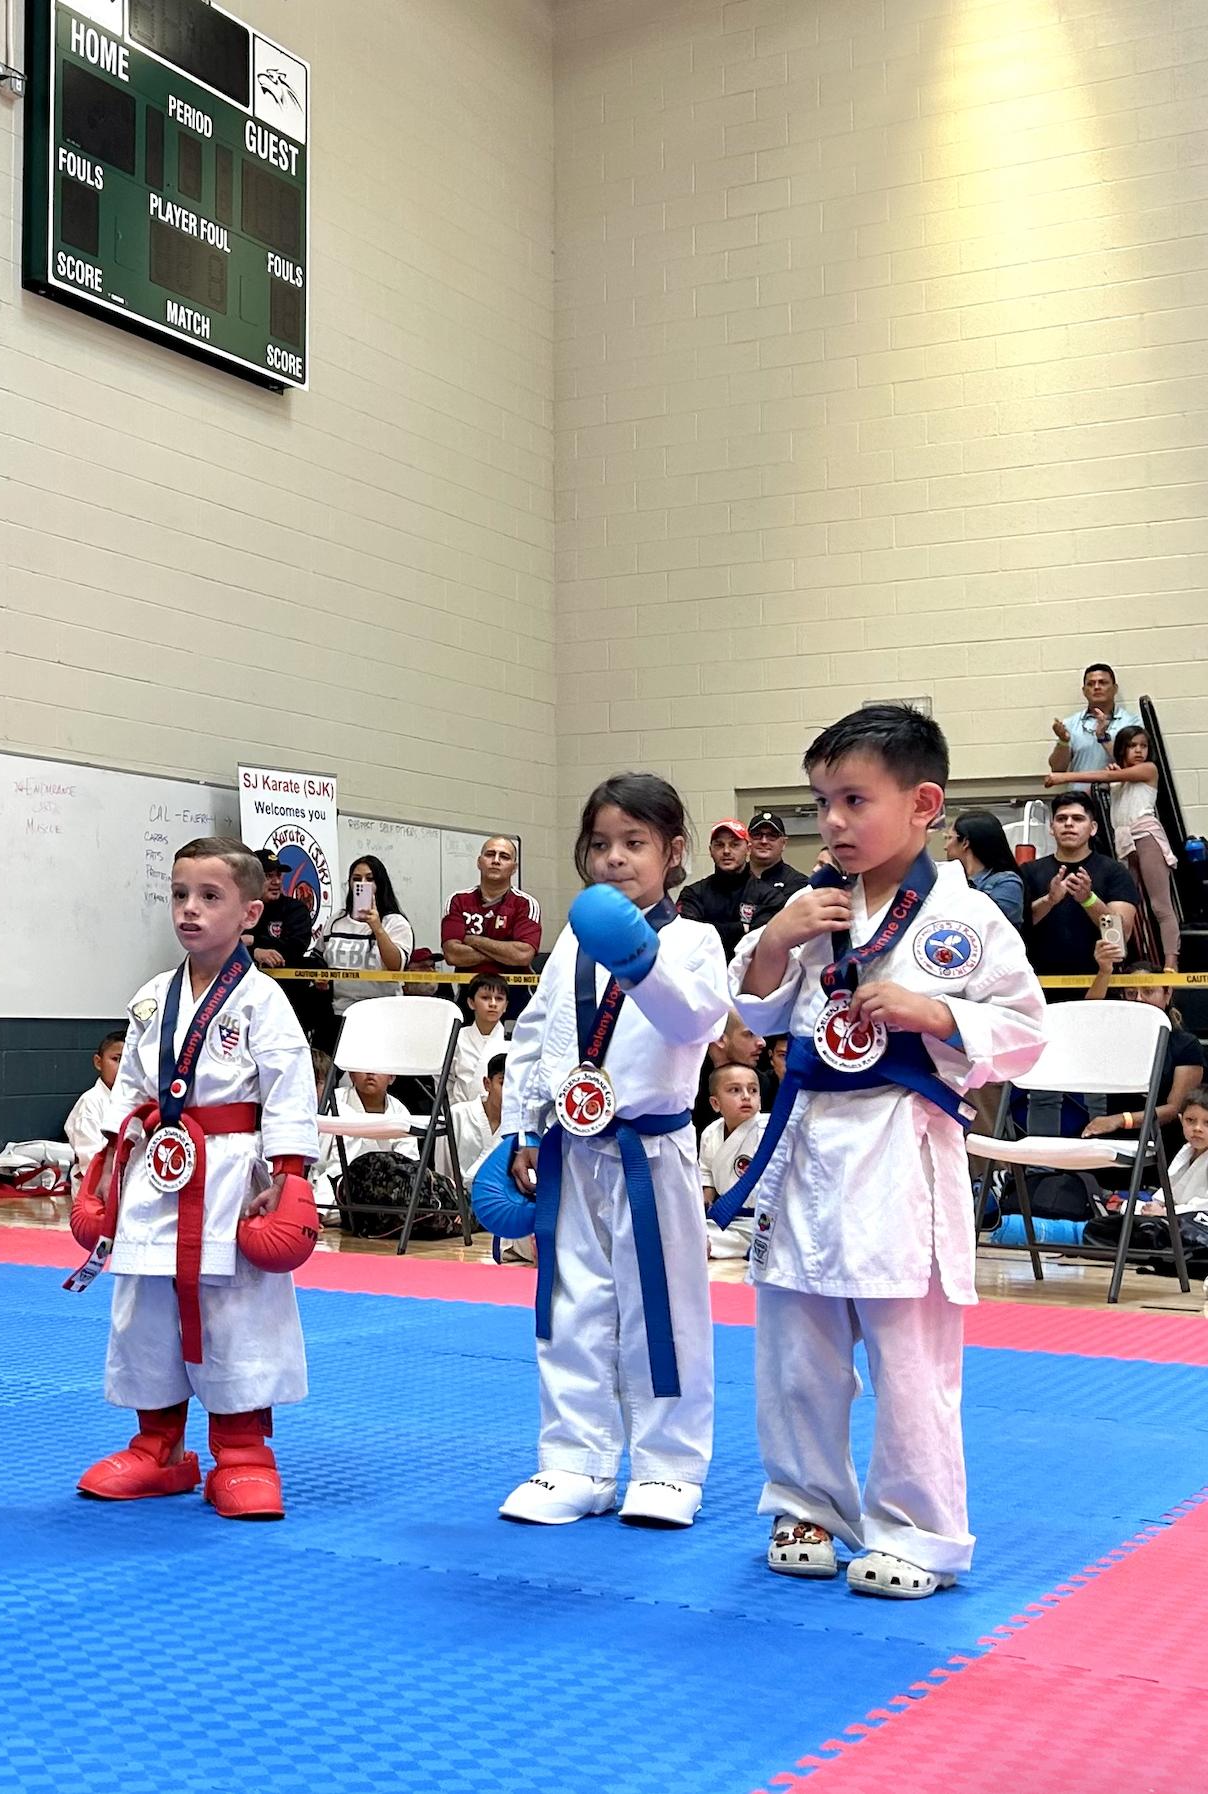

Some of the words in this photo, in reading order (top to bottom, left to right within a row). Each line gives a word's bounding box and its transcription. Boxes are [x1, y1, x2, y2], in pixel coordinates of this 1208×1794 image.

[71, 18, 130, 82] HOME
[168, 95, 212, 138] PERIOD
[245, 120, 299, 176] GUEST
[58, 147, 104, 190] FOULS
[149, 192, 197, 237] PLAYER
[200, 213, 231, 253] FOUL
[57, 251, 103, 293] SCORE
[267, 252, 303, 288] FOULS
[166, 300, 210, 339] MATCH
[266, 344, 303, 378] SCORE
[243, 772, 258, 789] SJ
[262, 775, 300, 794] Karate
[304, 780, 334, 801] (SJK)
[254, 800, 305, 818] Welcomes
[308, 810, 326, 822] you
[272, 827, 306, 849] Karate
[893, 890, 919, 920] Cup
[196, 986, 227, 1028] Joanne
[221, 961, 243, 984] Cup
[330, 971, 341, 979] NOT
[342, 971, 360, 979] ENTER
[524, 976, 535, 984] NOT
[587, 1011, 613, 1057] Seleny
